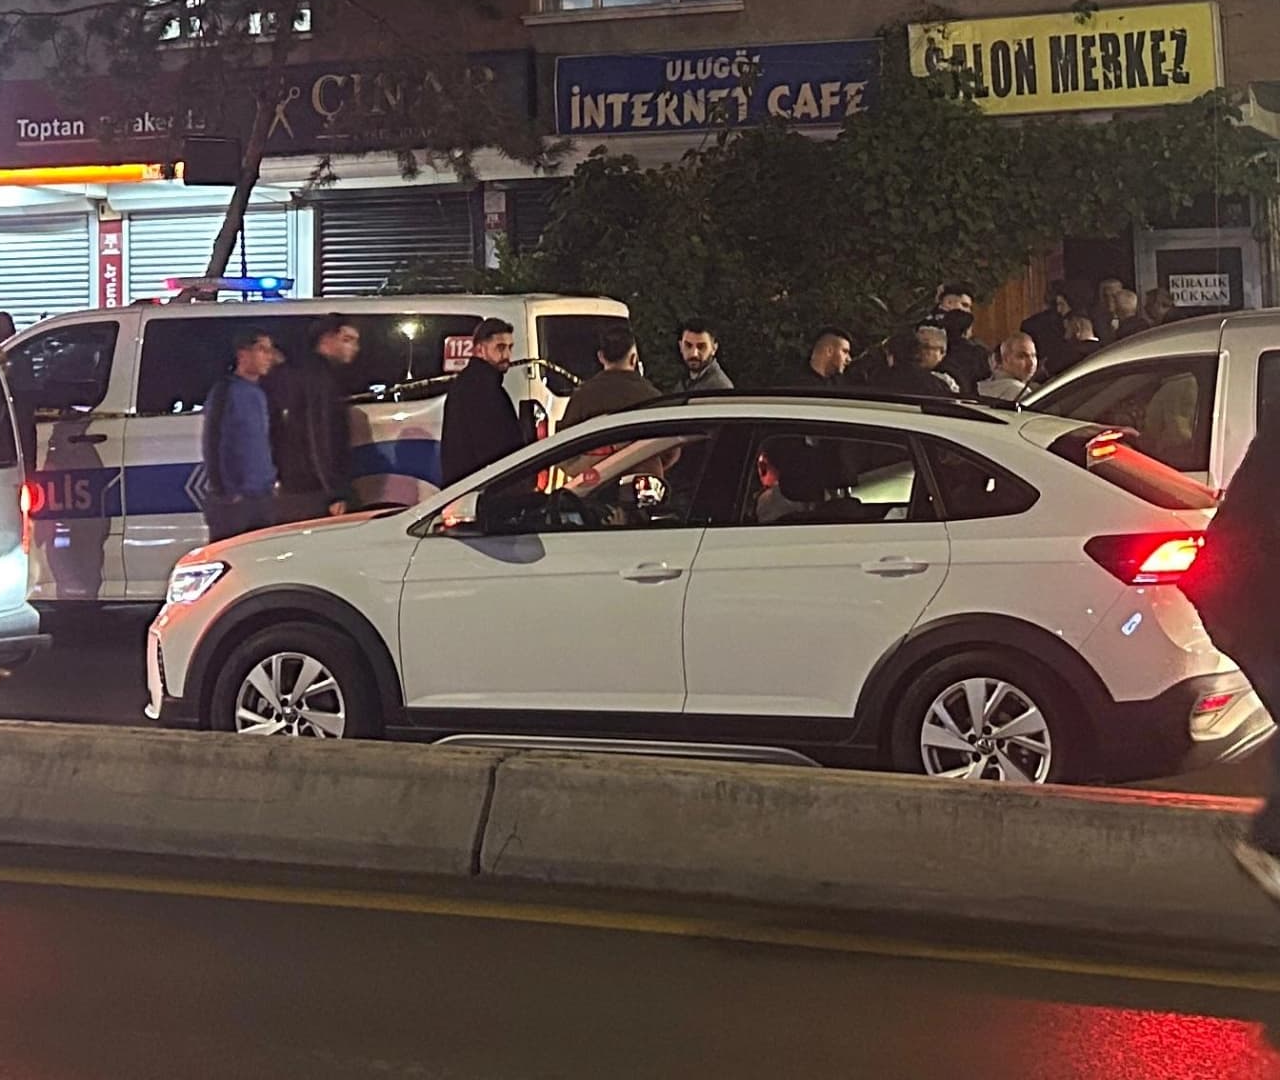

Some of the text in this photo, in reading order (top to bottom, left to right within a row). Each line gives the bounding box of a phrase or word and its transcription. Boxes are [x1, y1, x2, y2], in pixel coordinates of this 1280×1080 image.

[925, 27, 1190, 100] SALON MERKEZ
[767, 80, 870, 120] CAFE
[16, 119, 84, 141] Toptan
[449, 340, 474, 357] 112
[26, 473, 93, 513] OLİS
